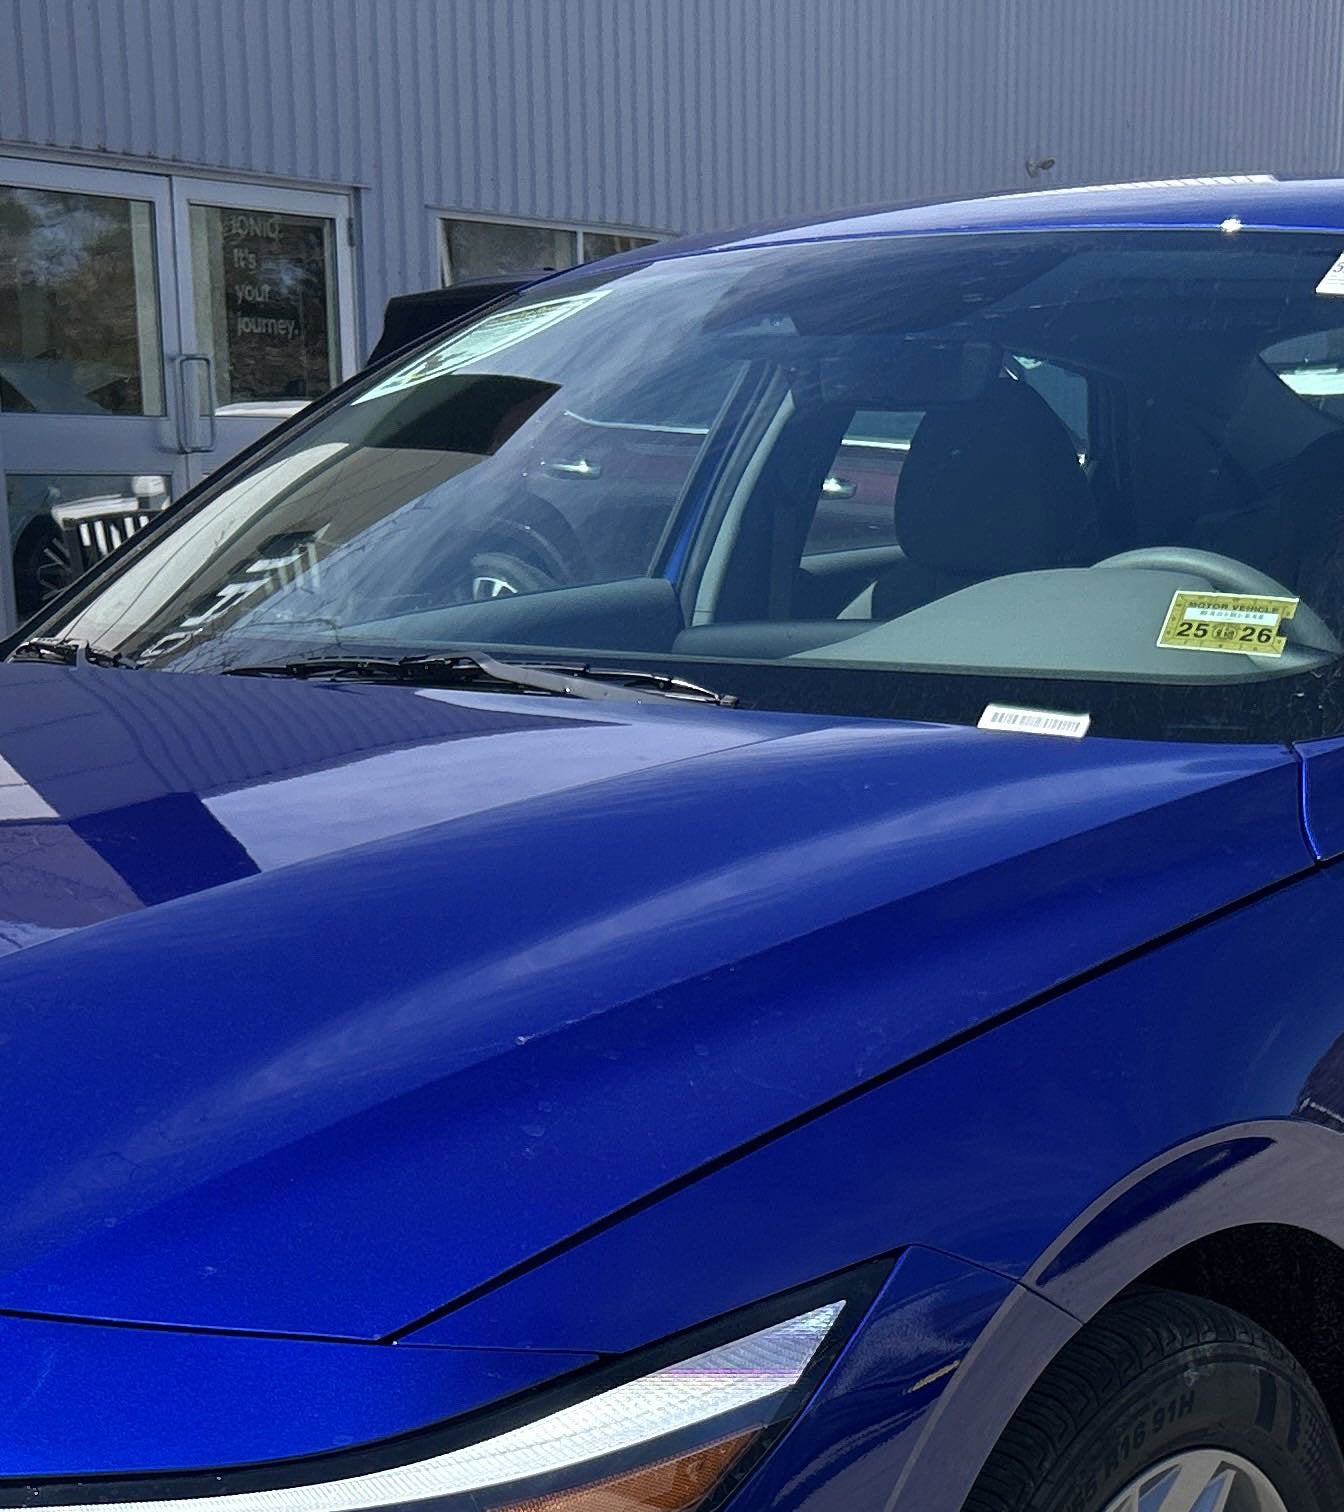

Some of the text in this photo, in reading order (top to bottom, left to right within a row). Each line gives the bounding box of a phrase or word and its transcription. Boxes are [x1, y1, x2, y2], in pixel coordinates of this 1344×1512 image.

[233, 247, 257, 269] It's
[234, 282, 271, 305] your
[237, 312, 300, 340] journey.
[1188, 601, 1280, 614] MOTOR VEHICLE
[1176, 622, 1210, 638] 25
[1239, 626, 1273, 643] 26
[1152, 1390, 1195, 1433] 91H
